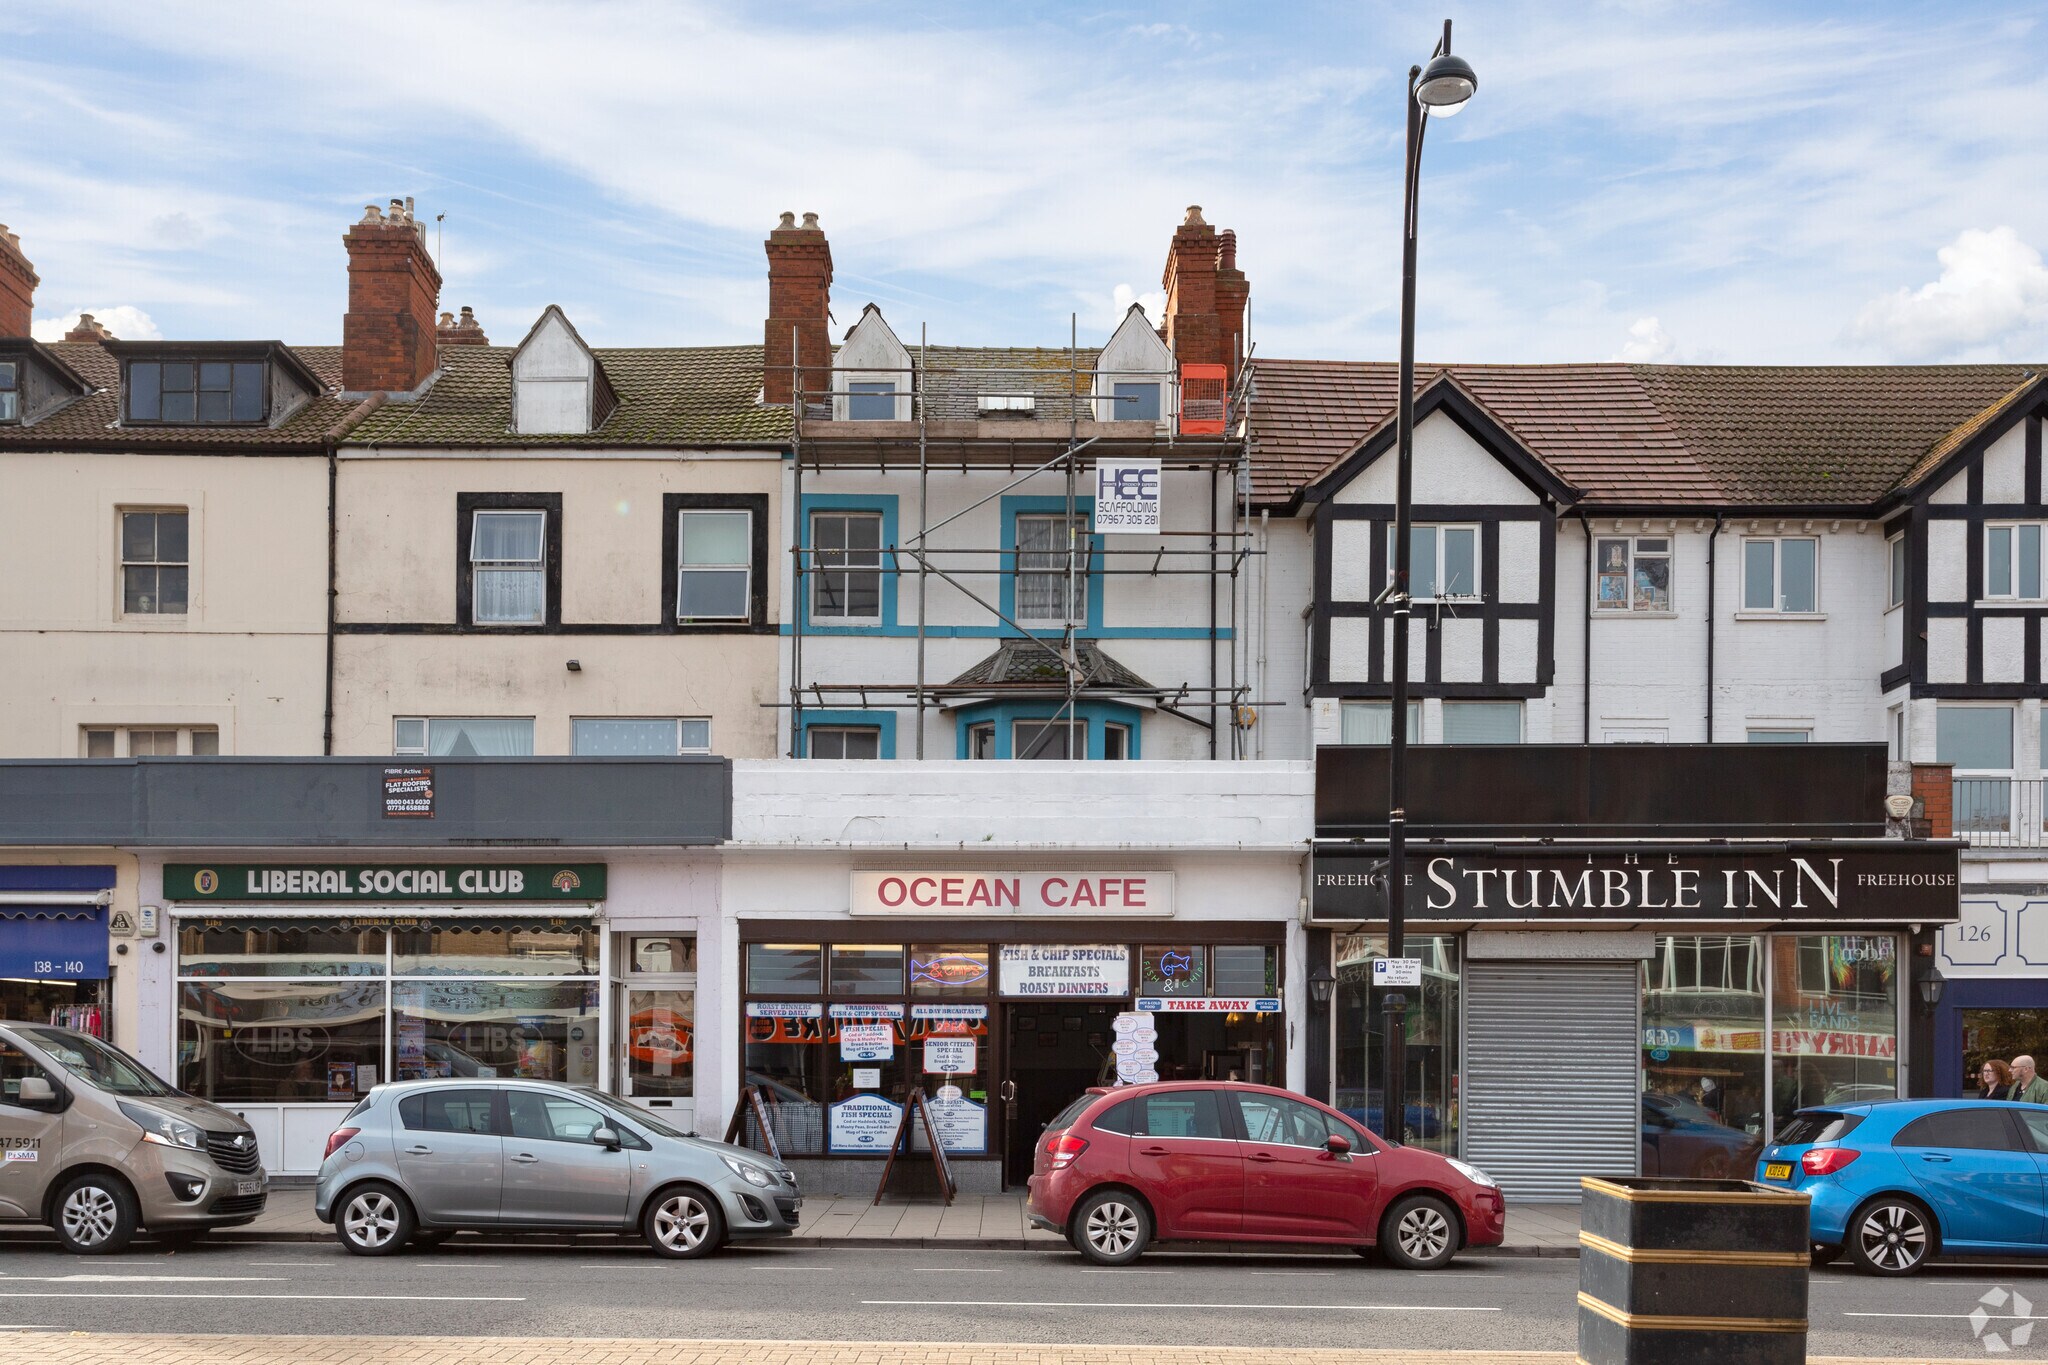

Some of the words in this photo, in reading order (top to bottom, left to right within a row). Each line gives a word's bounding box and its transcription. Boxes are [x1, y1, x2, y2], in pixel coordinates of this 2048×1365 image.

[1098, 502, 1158, 513] SCAFFOLDING
[1097, 514, 1125, 525] 07967
[1126, 515, 1142, 525] 305
[1144, 515, 1158, 525] 281
[247, 869, 351, 893] LIBERAL
[358, 869, 453, 894] SOCIAL
[458, 869, 525, 894] CLUB
[1426, 857, 1702, 910] STUMBLE
[1721, 858, 1845, 909] INN
[1857, 874, 1955, 886] FREEHOUSE
[877, 877, 1021, 907] OCEAN
[1040, 877, 1147, 907] CAFE
[353, 918, 391, 926] LIBERAL
[394, 918, 418, 926] CLUB
[1957, 925, 1992, 942] 126
[1003, 949, 1029, 961] FISH
[1031, 949, 1040, 961] &
[1042, 949, 1070, 961] CHIP
[1072, 949, 1126, 961] SPECIALS
[34, 961, 52, 973] 138
[65, 961, 84, 973] 140
[944, 966, 980, 977] CHIPS
[1028, 965, 1100, 977] BREAKFASTS
[1019, 982, 1056, 994] ROAST
[1058, 982, 1109, 994] DINNERS
[1163, 978, 1174, 993] &
[1167, 1001, 1206, 1010] TAKE
[1208, 1001, 1250, 1010] AWAY
[1809, 1000, 1848, 1016] LIVE
[936, 1020, 966, 1031] OPEN
[1809, 1013, 1861, 1031] BANDS
[252, 1027, 313, 1053] LIBS
[465, 1026, 527, 1053] LIBS
[15, 1137, 41, 1149] 5911
